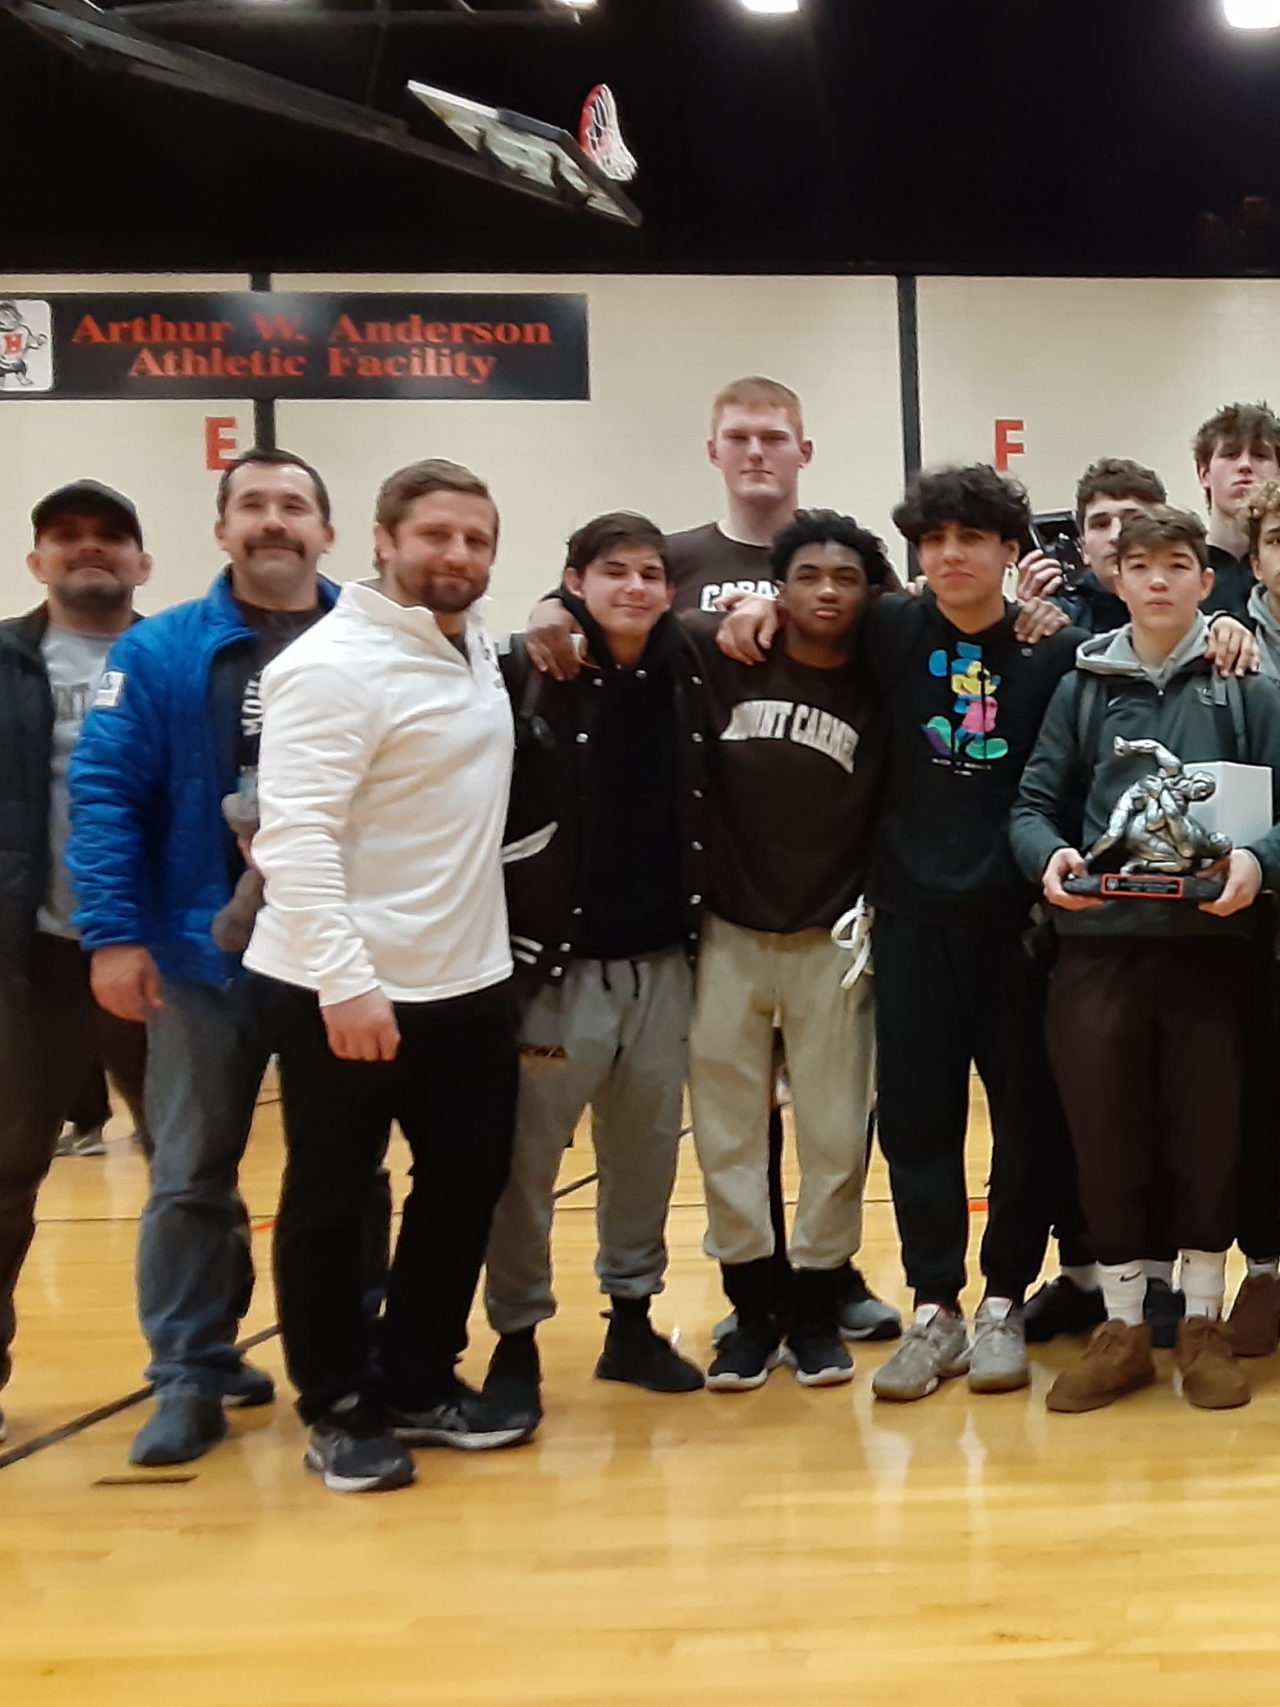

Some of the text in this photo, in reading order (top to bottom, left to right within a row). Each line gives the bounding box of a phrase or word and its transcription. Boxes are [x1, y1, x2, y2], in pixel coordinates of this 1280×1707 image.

[72, 312, 551, 344] Arthur W. Anderson
[128, 346, 497, 384] Athletic Facility
[205, 416, 237, 470] E
[995, 419, 1024, 473] F
